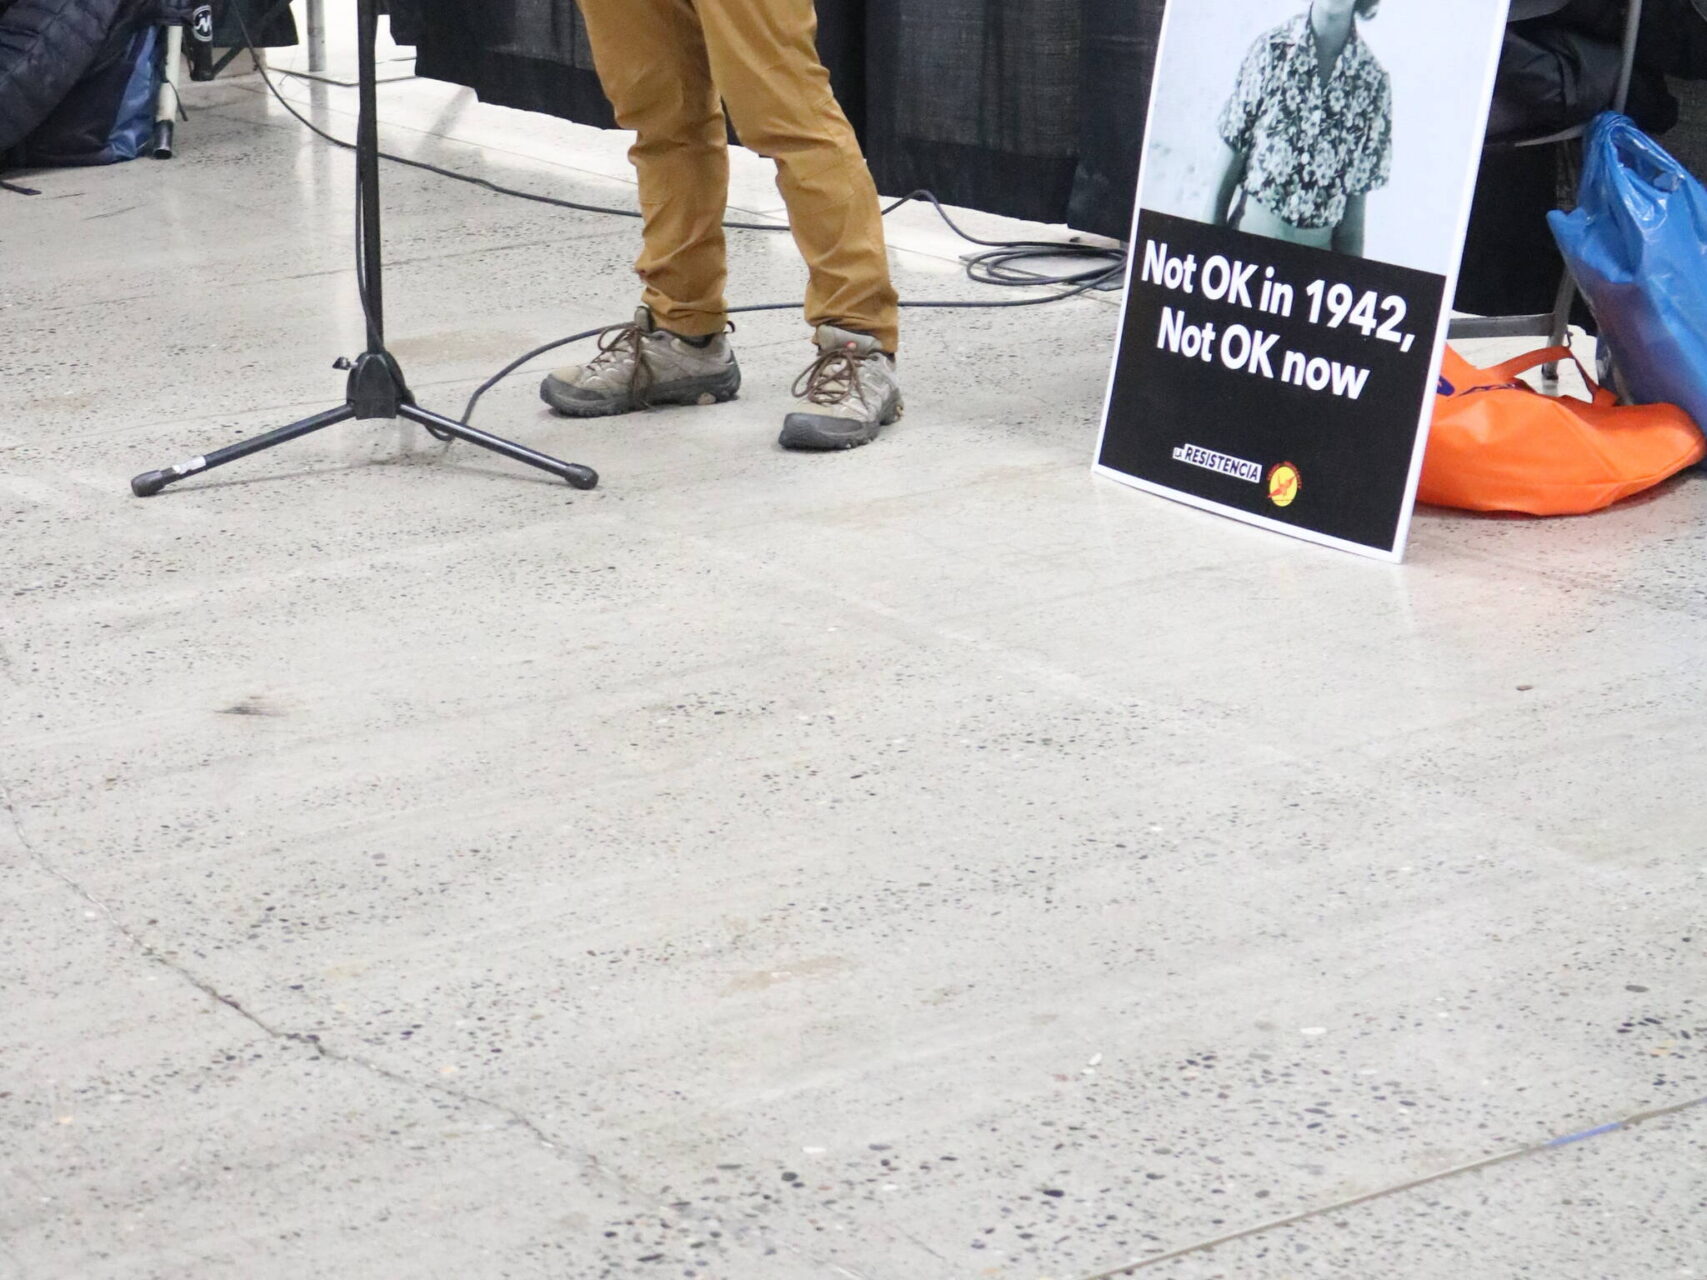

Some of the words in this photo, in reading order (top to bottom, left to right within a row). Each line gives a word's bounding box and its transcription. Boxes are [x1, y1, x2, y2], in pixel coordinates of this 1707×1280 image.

[1141, 239, 1198, 294] Not
[1201, 254, 1259, 309] OK
[1259, 265, 1294, 318] in
[1305, 279, 1416, 353] 1942,
[1156, 306, 1217, 363] Not
[1220, 323, 1281, 379] OK
[1280, 350, 1371, 400] now
[1184, 445, 1261, 482] RESISTENCIA
